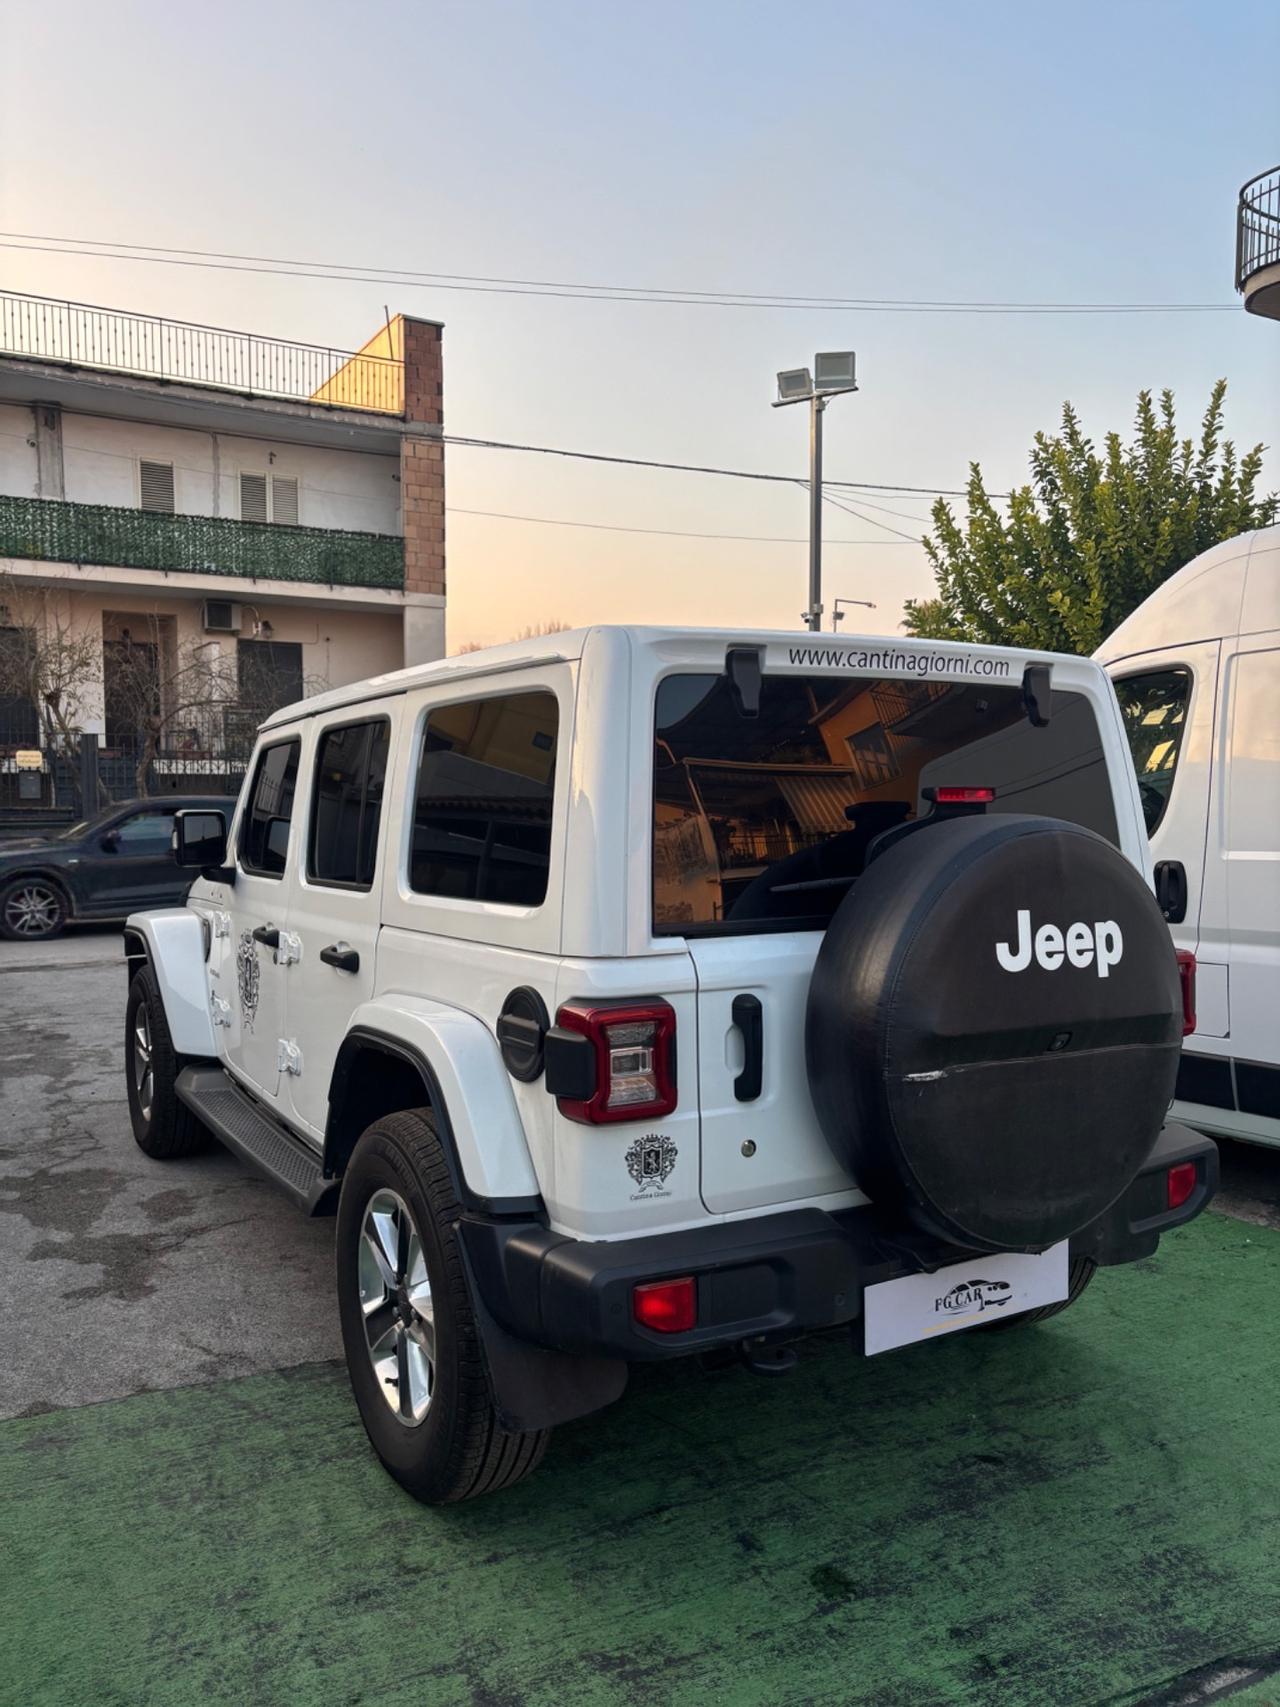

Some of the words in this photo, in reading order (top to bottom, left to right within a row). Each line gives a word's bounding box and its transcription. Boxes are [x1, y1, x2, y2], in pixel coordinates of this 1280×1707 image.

[789, 648, 1010, 676] www.cantinagiorni.com
[995, 909, 1123, 978] Jeep
[935, 1296, 952, 1312] FG
[955, 1287, 984, 1311] CAR
